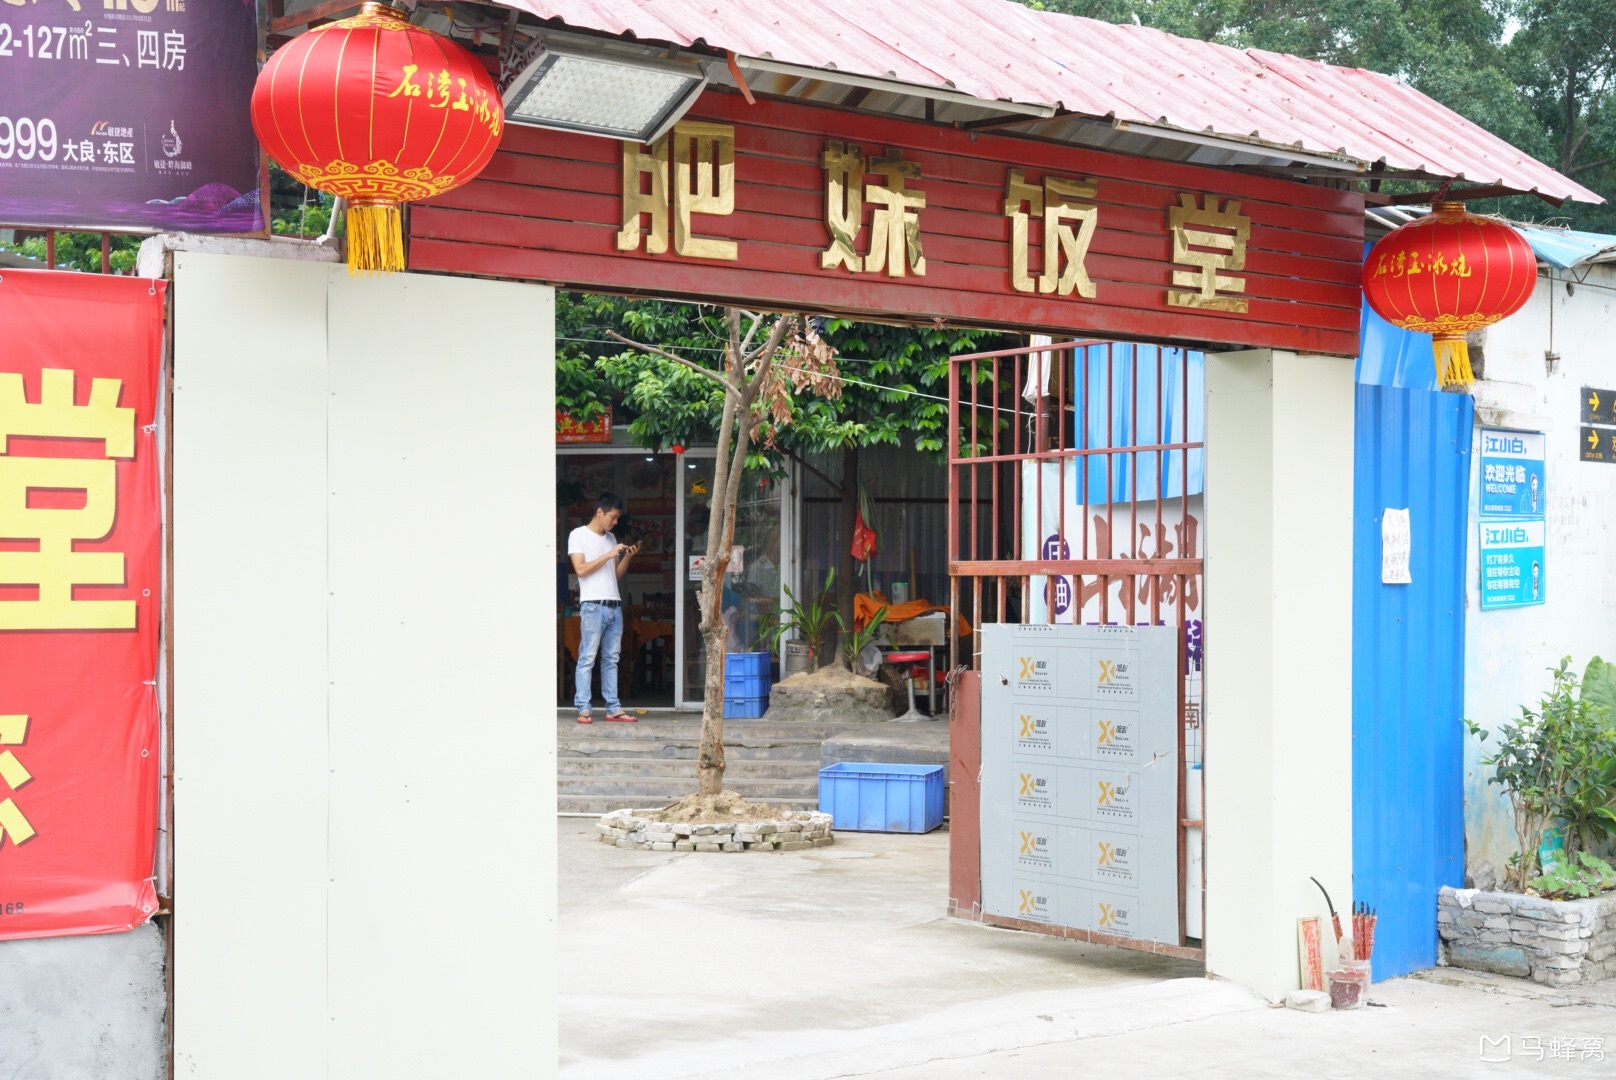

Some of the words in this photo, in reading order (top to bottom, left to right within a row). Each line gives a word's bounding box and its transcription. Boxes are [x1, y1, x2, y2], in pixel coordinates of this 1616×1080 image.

[62, 139, 135, 164] 大良·东区
[615, 119, 1251, 313] 肥妹饭堂
[1485, 435, 1524, 454] 江小白
[1485, 464, 1526, 484] 欢迎光临
[1485, 483, 1517, 494] WELCOME
[0, 368, 138, 630] 堂
[1485, 527, 1526, 545] 江小白
